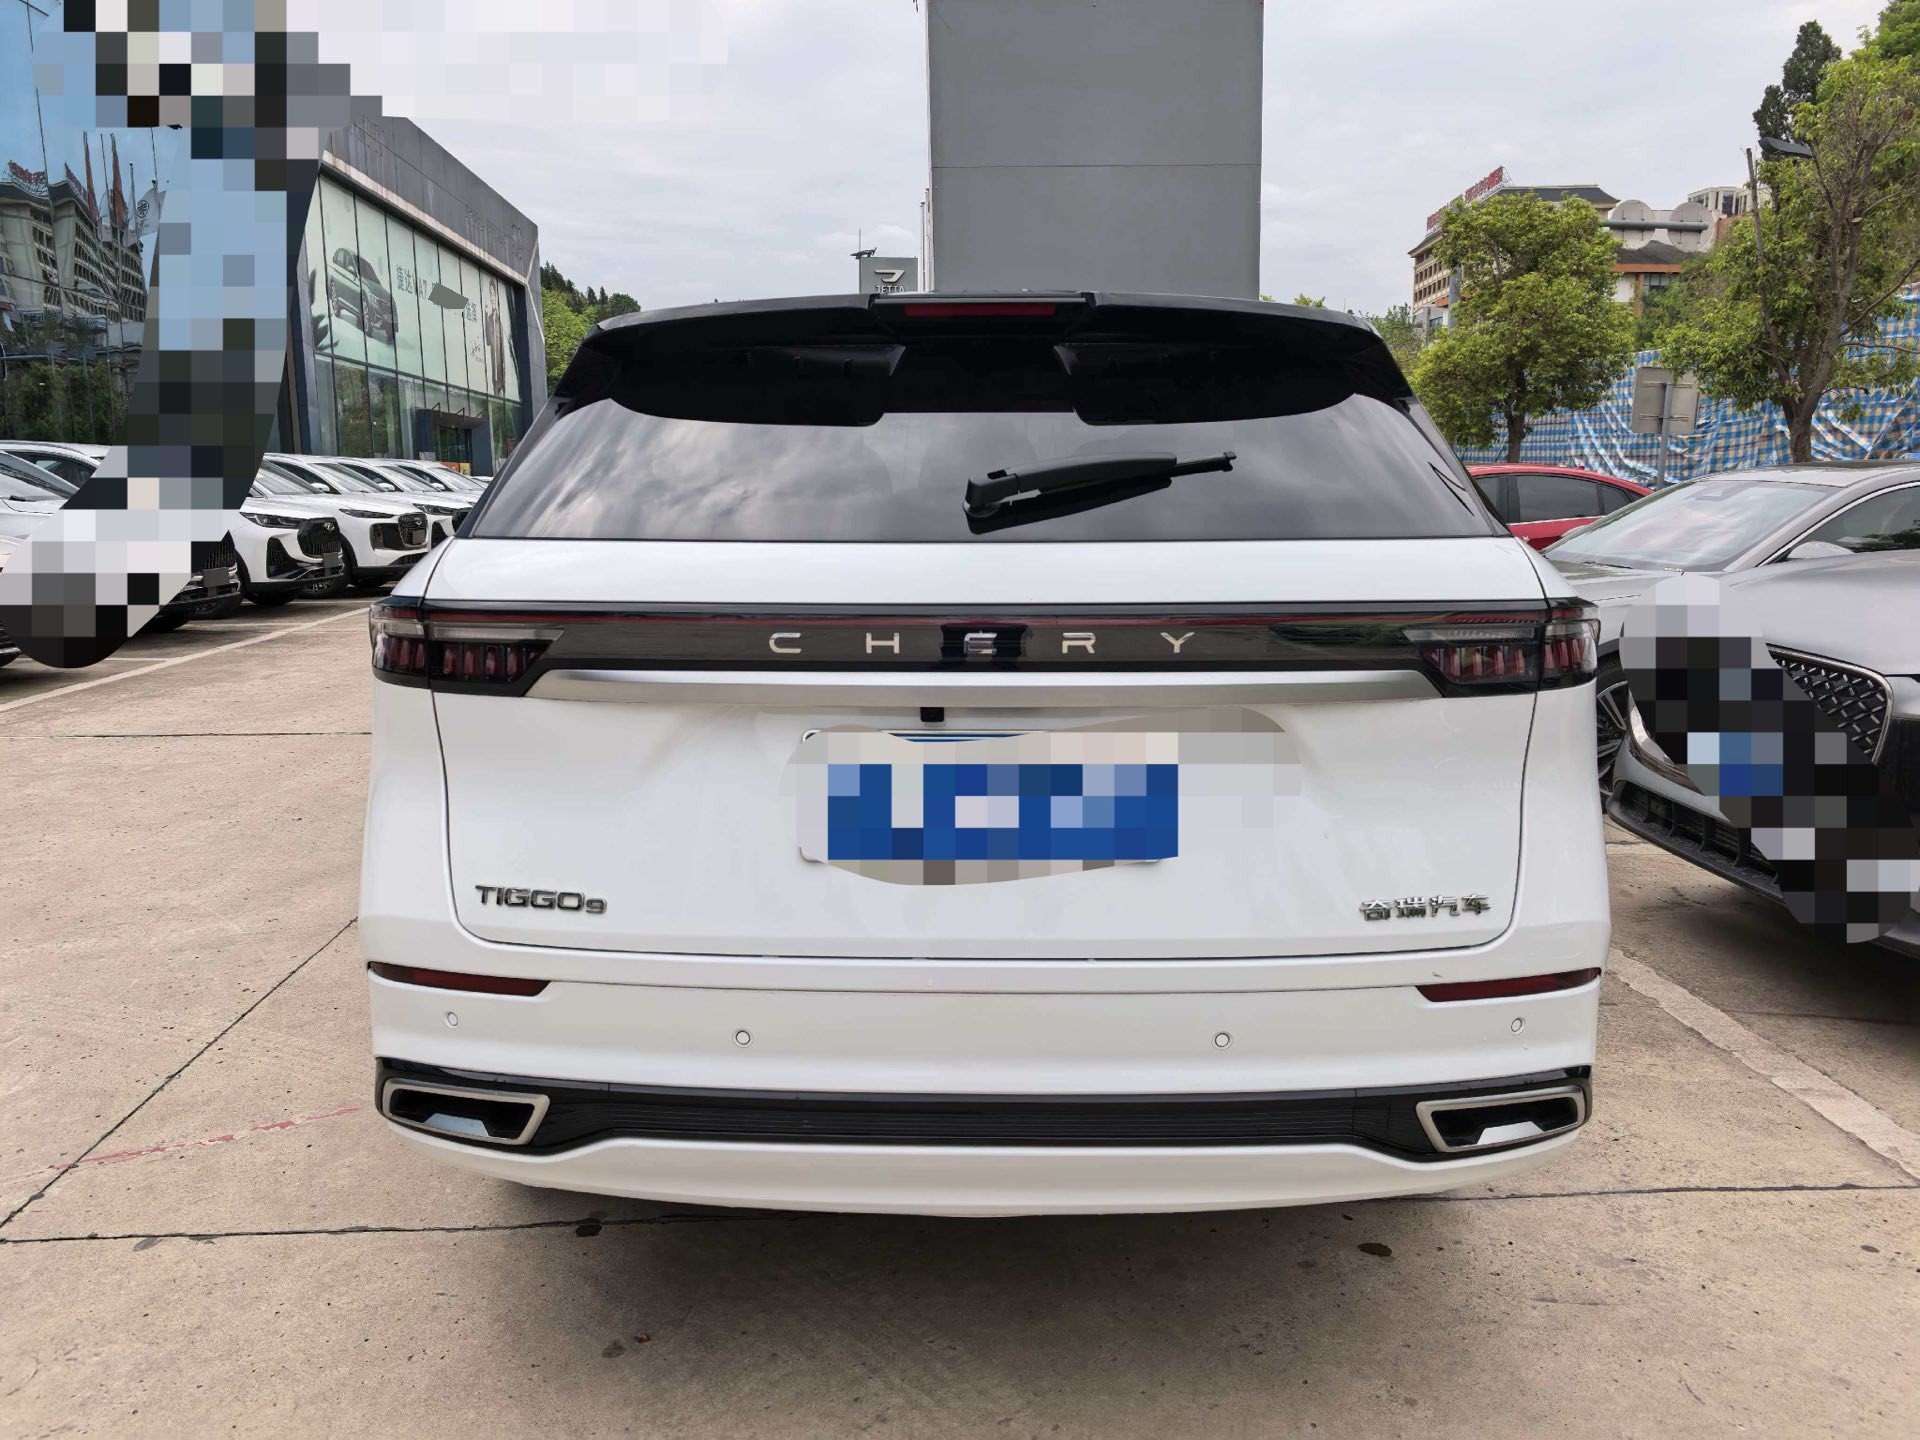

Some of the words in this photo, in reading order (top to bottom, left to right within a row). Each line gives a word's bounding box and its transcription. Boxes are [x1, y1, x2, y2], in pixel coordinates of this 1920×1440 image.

[875, 285, 905, 293] JETTA
[768, 631, 1196, 655] CHERY
[1360, 893, 1492, 921] 奇瑞汽车
